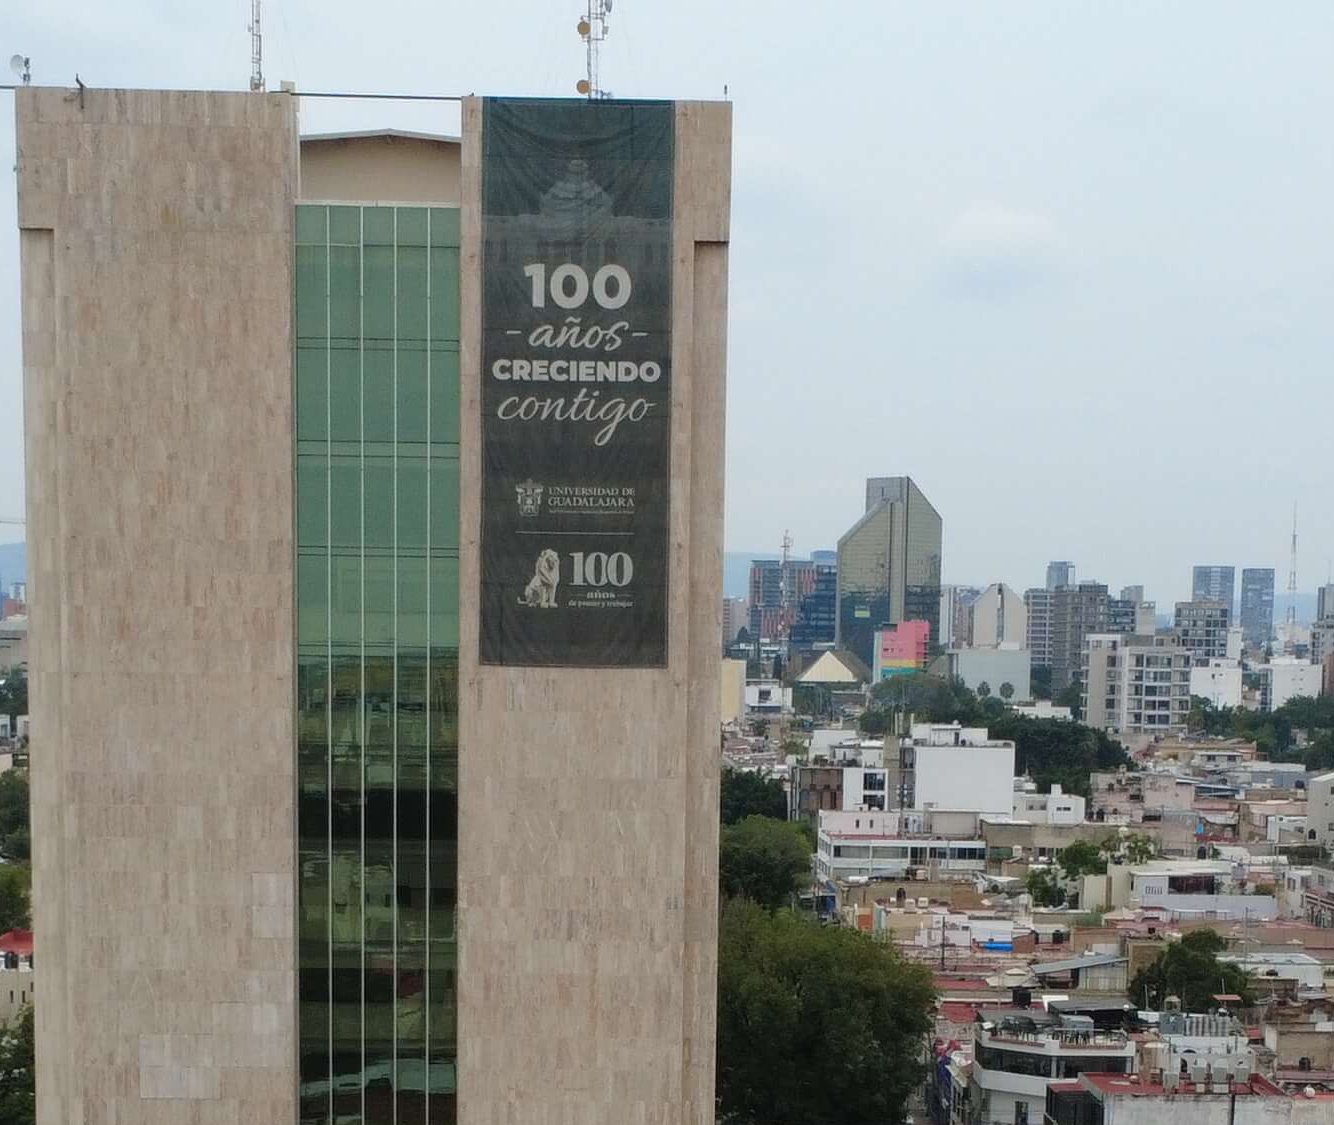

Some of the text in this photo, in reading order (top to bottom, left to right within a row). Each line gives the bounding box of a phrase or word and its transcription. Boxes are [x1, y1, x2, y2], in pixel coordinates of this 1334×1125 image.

[523, 263, 632, 310] 100
[529, 317, 629, 352] años
[492, 359, 661, 383] CRECIENDO
[497, 387, 656, 446] contigo
[548, 487, 635, 496] UNIVERSIDAD DE
[548, 497, 635, 507] GUADALAJARA
[569, 551, 634, 587] 100
[586, 590, 616, 599] años
